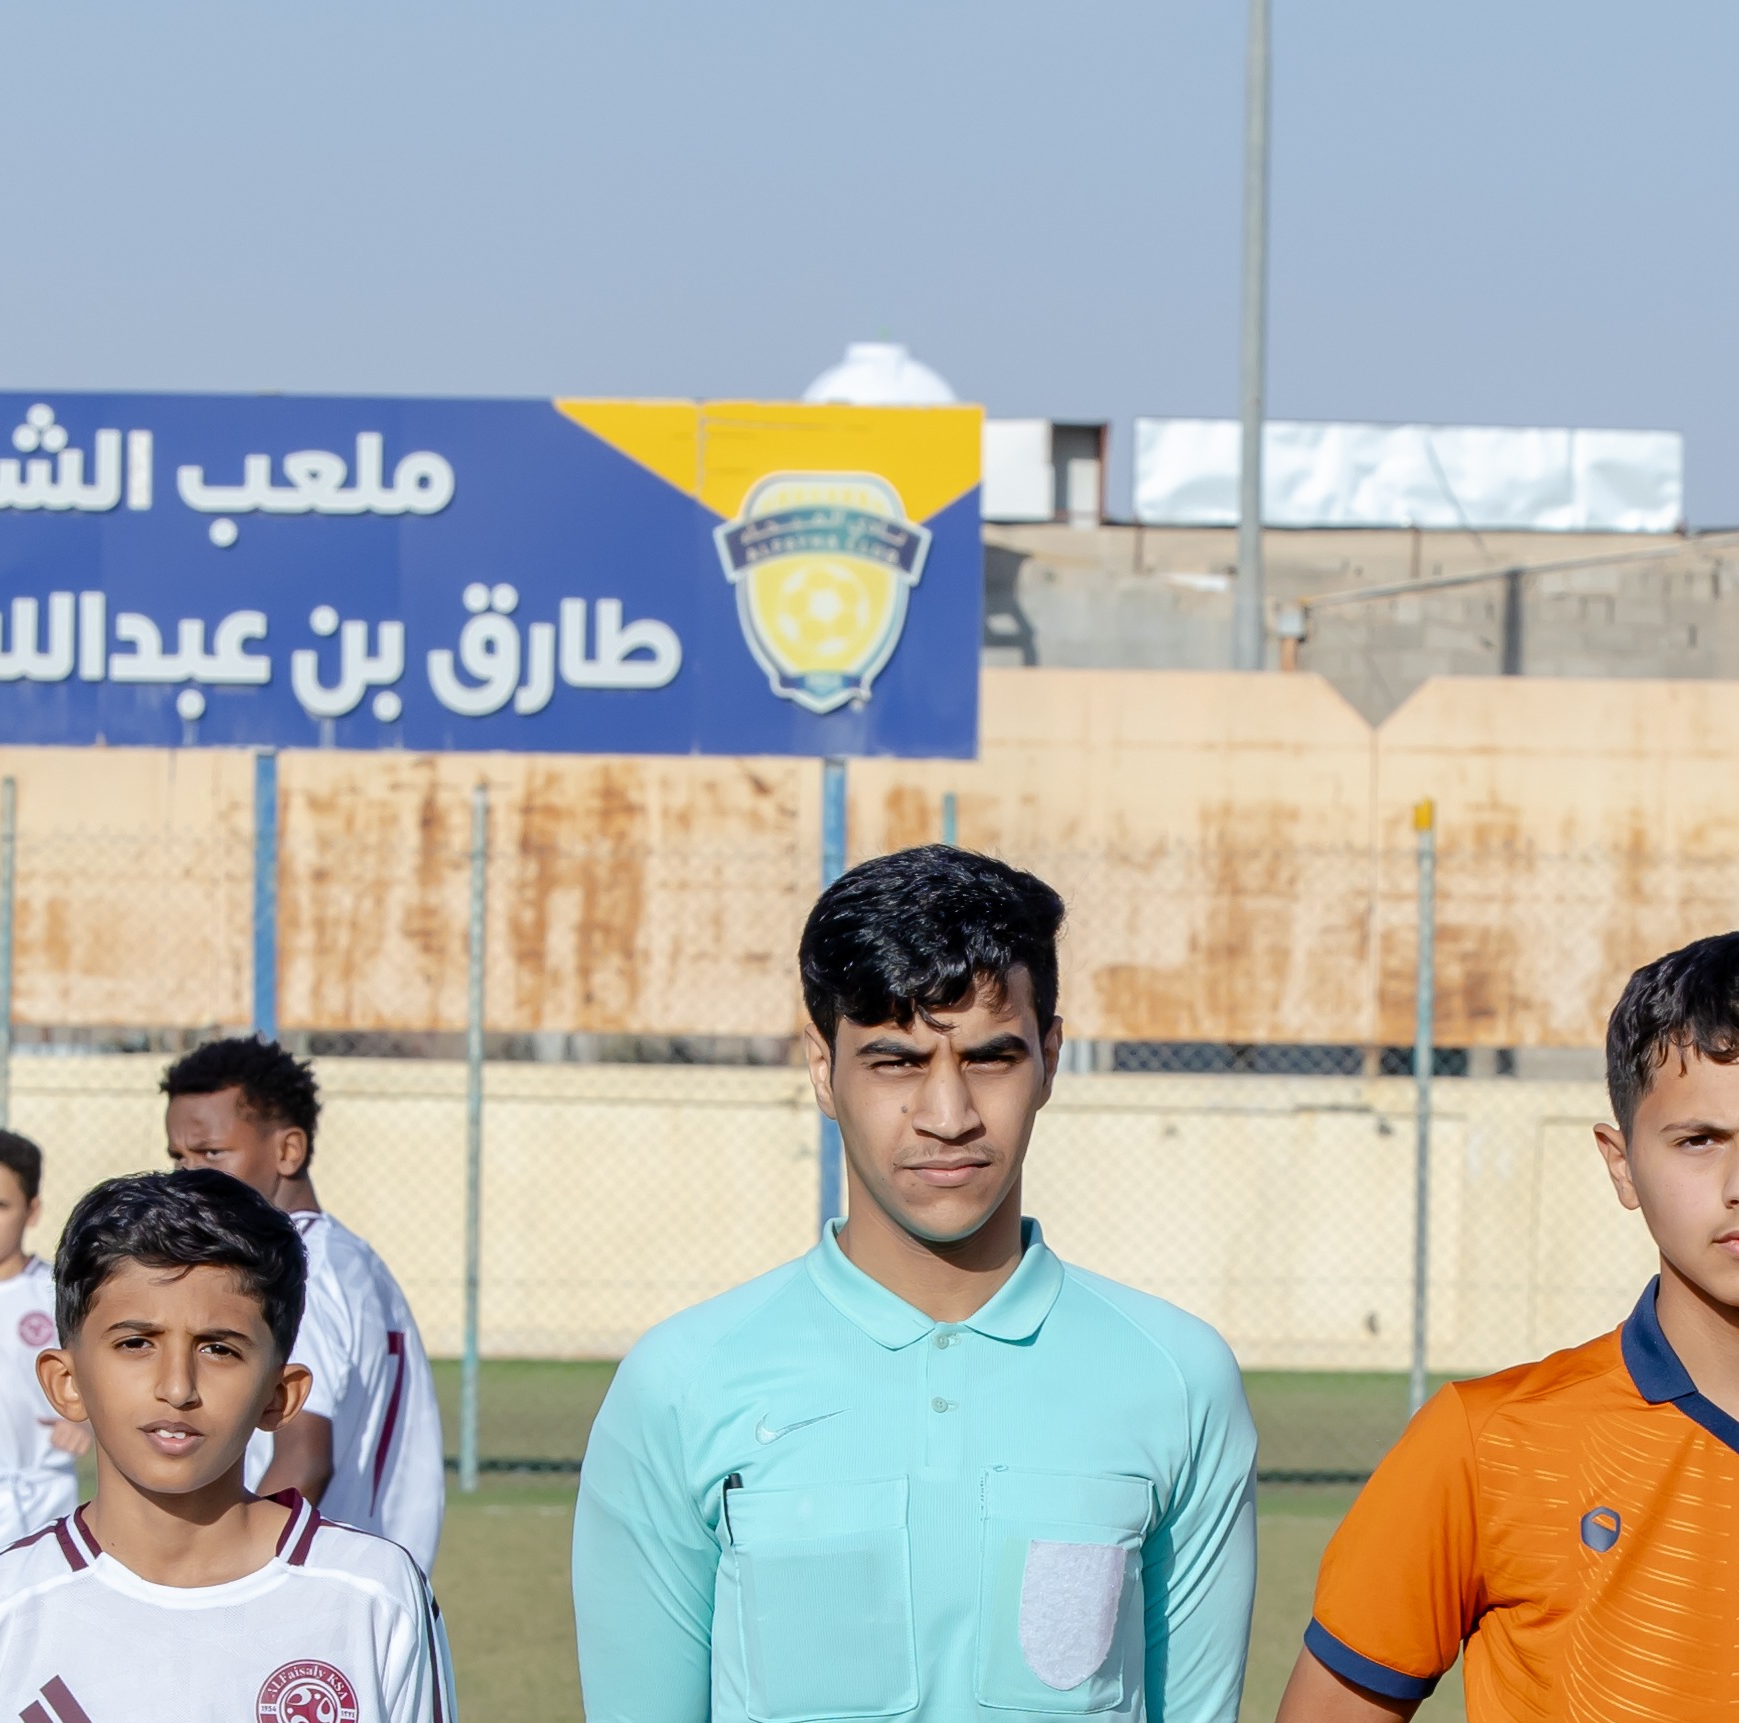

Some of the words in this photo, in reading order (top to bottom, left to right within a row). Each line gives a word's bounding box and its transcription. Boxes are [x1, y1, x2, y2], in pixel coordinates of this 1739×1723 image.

[176, 431, 455, 547] ملعب
[291, 604, 405, 722] بن
[426, 582, 683, 716] طارق
[326, 1673, 349, 1701] KSA
